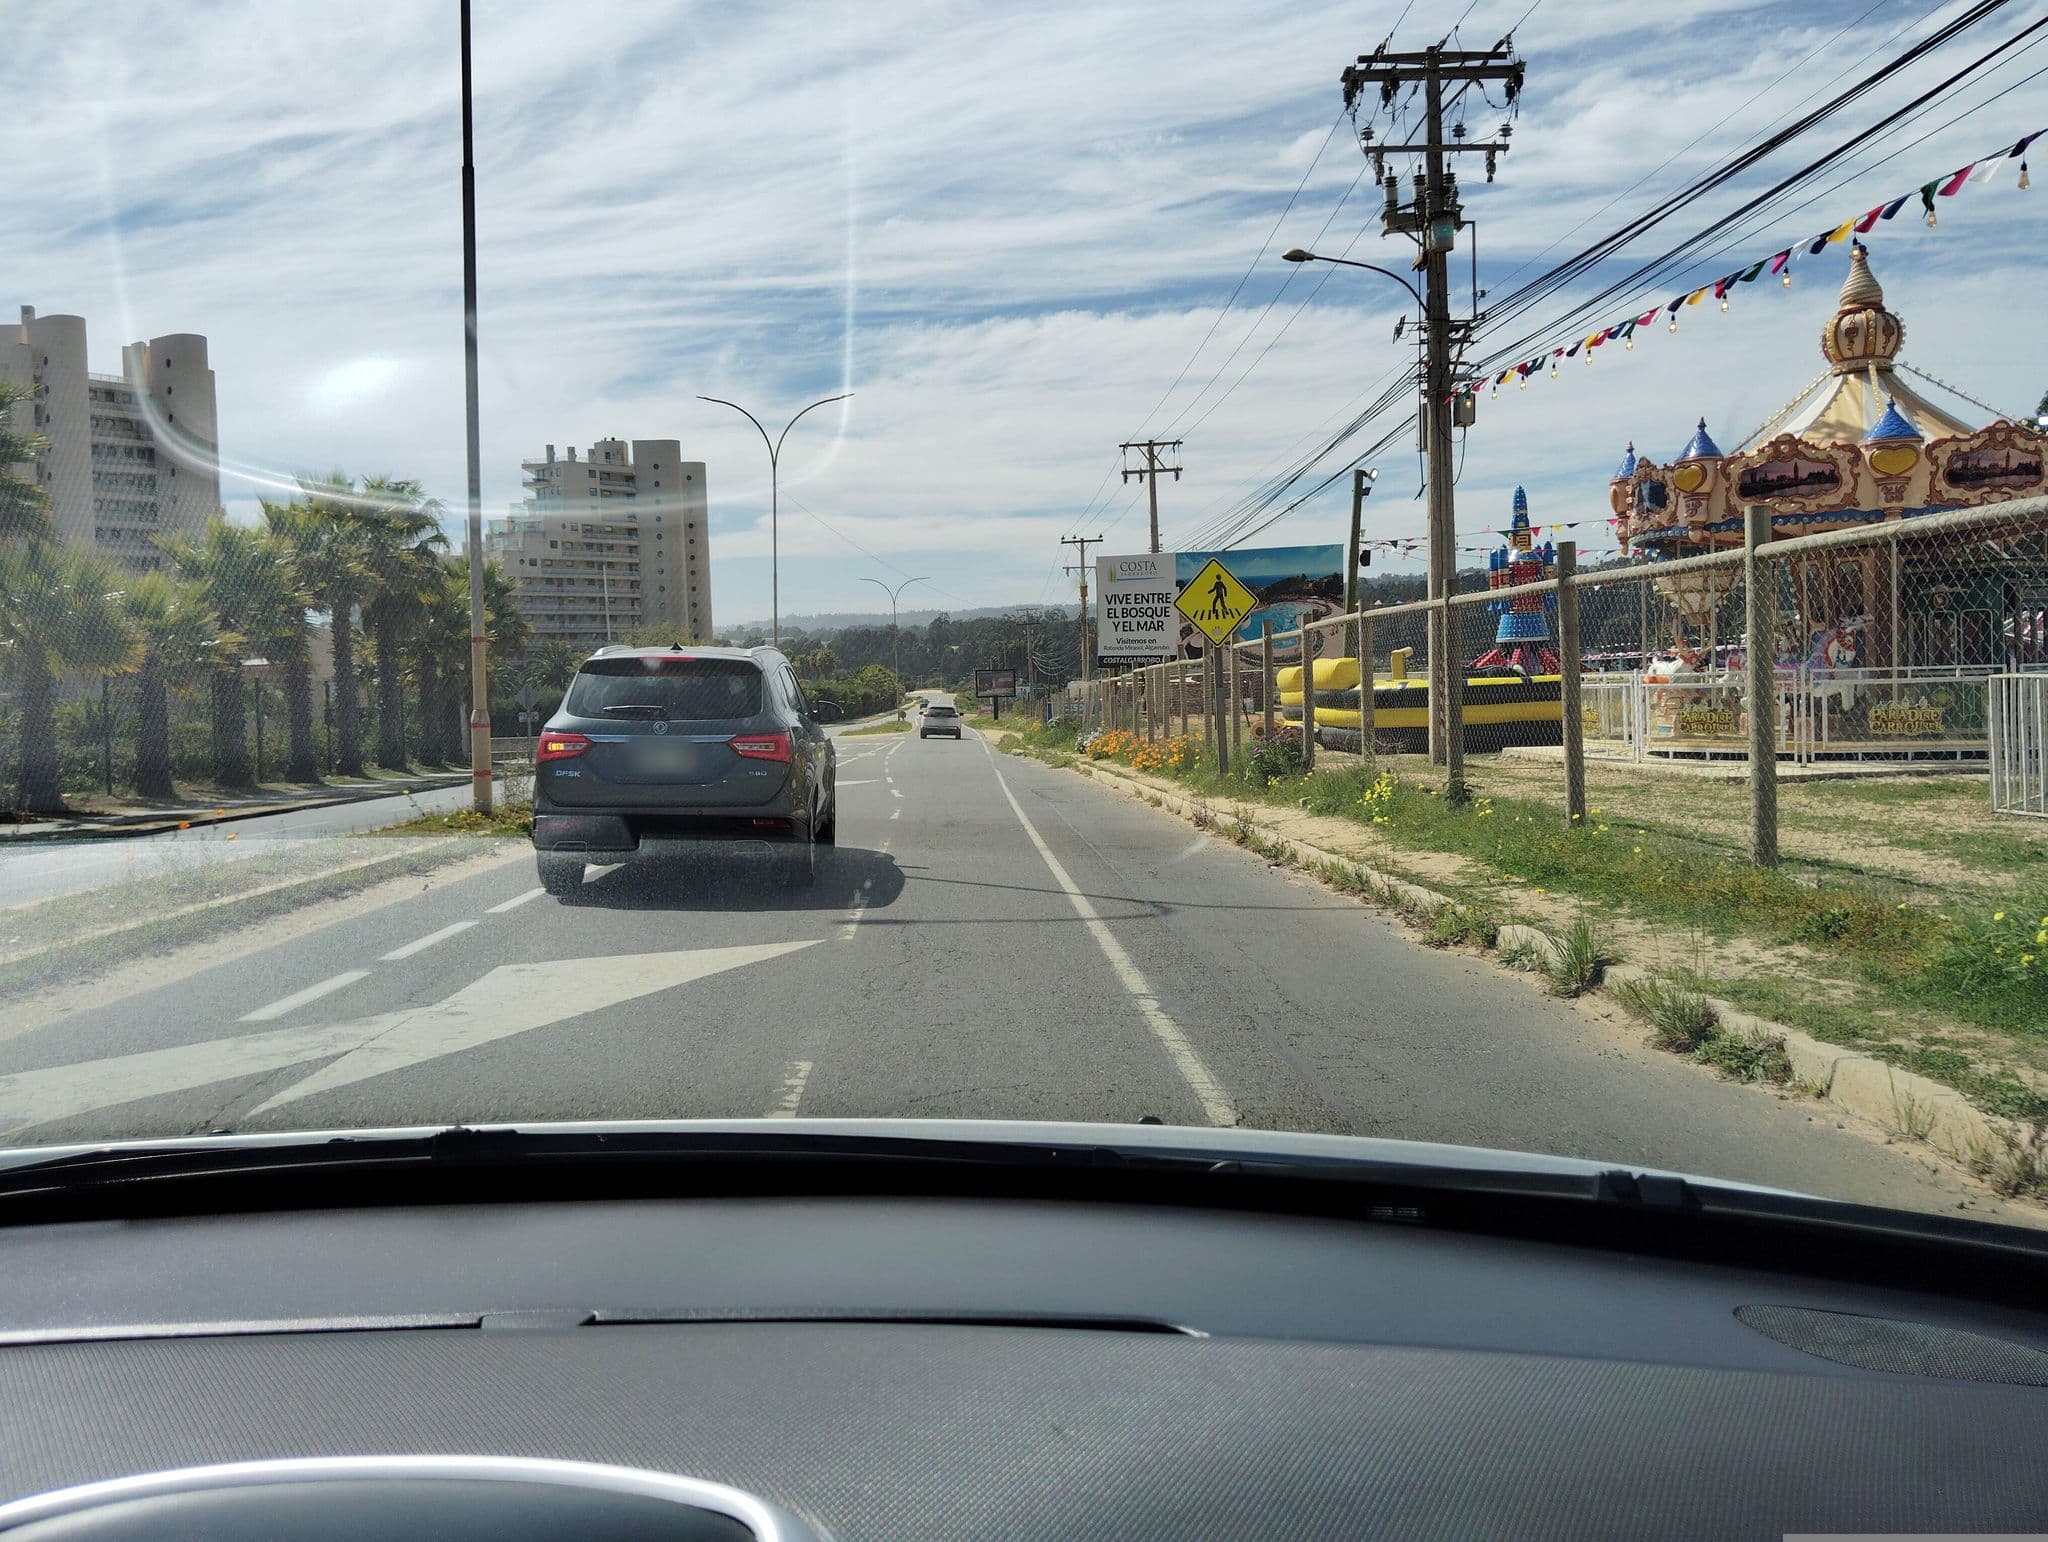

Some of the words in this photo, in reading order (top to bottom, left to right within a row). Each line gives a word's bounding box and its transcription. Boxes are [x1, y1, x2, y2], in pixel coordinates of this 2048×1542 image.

[1120, 561, 1157, 572] COSTA
[1105, 594, 1132, 605] VIVE
[1134, 592, 1172, 604] ENTRE
[1107, 608, 1119, 619] EL
[1121, 607, 1171, 619] BOSQUE
[1112, 621, 1120, 632] Y
[1122, 621, 1135, 632] EL
[1137, 620, 1165, 631] MAR
[1680, 710, 1733, 723] PARADISE
[1871, 708, 1941, 721] PARADISE
[1870, 721, 1945, 735] CARROUSEL
